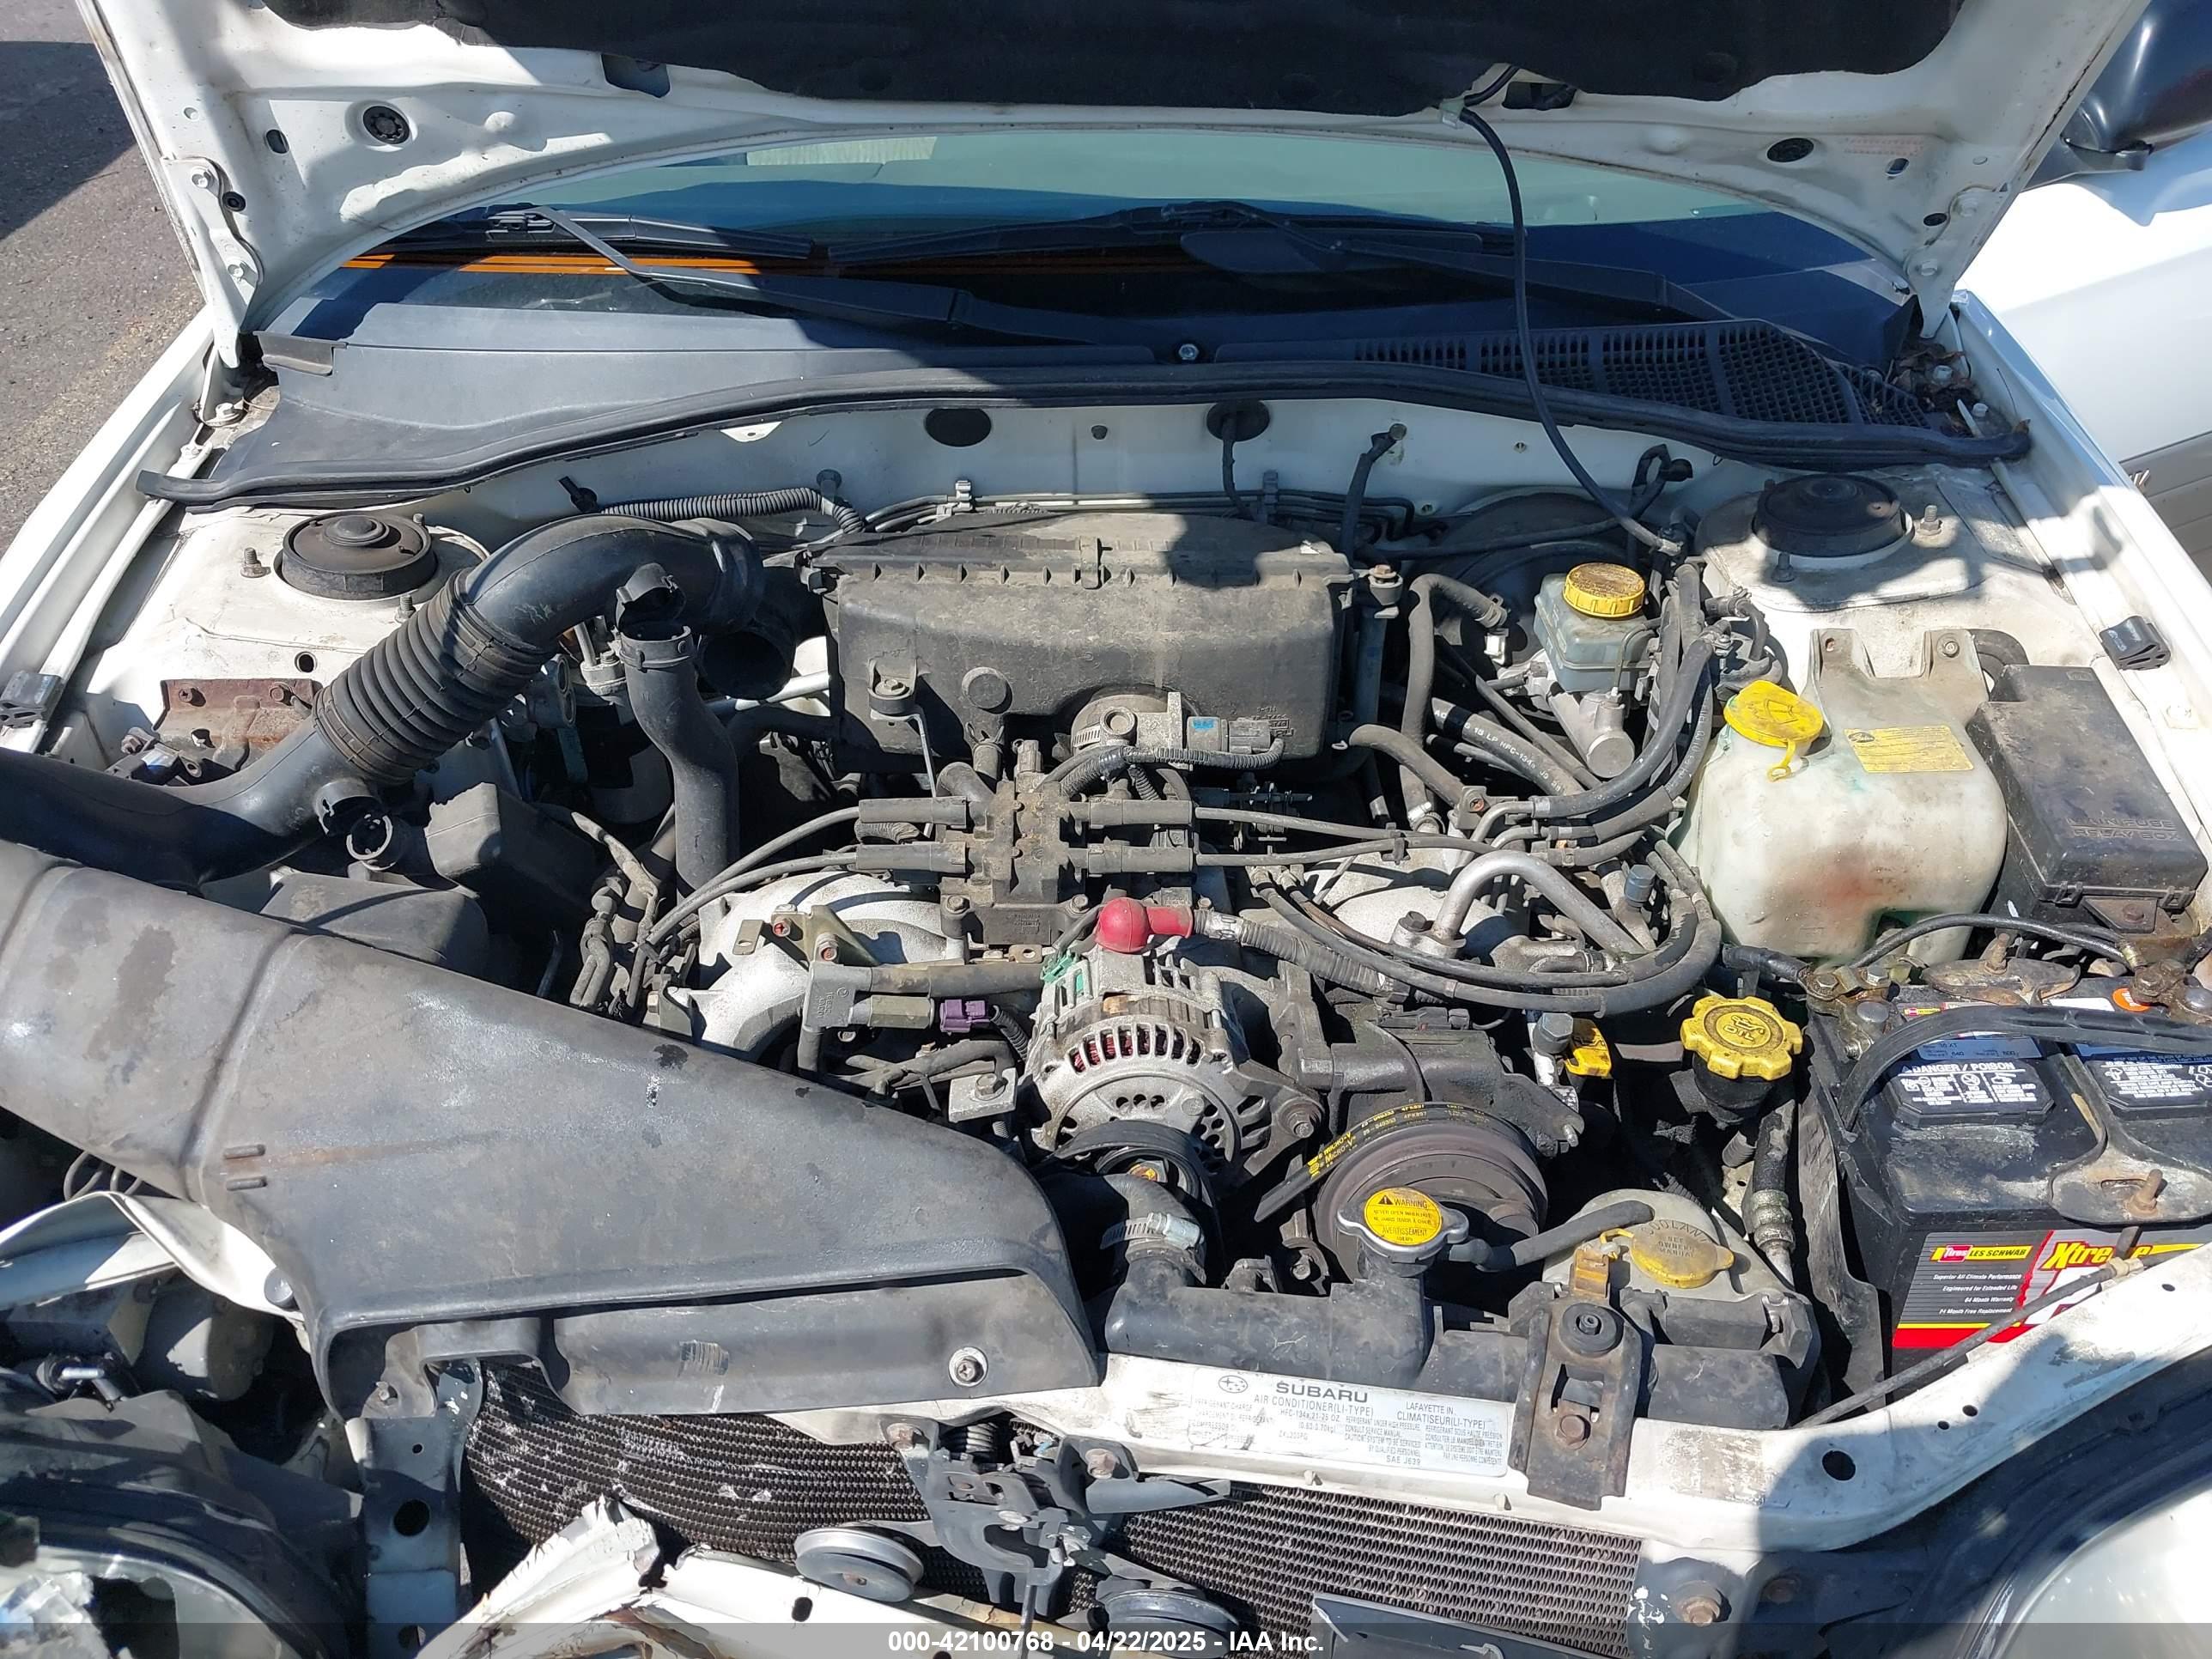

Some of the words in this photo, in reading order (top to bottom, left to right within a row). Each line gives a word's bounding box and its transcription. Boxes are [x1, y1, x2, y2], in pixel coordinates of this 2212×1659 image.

[2122, 819, 2176, 828] FUSE
[2142, 830, 2183, 840] BOX
[1723, 1024, 1754, 1041] OIL
[1911, 1063, 1960, 1073] DANGER
[1972, 1061, 2016, 1071] POISON
[1394, 1198, 1428, 1209] WARNING
[1382, 1225, 1427, 1237] AVERTISSEMENT
[1969, 1249, 1985, 1257] LES
[1986, 1248, 2027, 1257] SCHWAB
[2042, 1242, 2152, 1270] Xtree
[1276, 1381, 1368, 1403] SUBARU
[1253, 1394, 1269, 1405] AIR
[1272, 1395, 1374, 1417] CONDITIONER(LI-TYPE)
[1406, 1401, 1445, 1414] LAFAYETTE
[1396, 1411, 1486, 1430] CLIMATISEUR(LI-TYPE)
[1365, 1425, 1383, 1435] SERVICE
[1386, 1455, 1401, 1464] SAE
